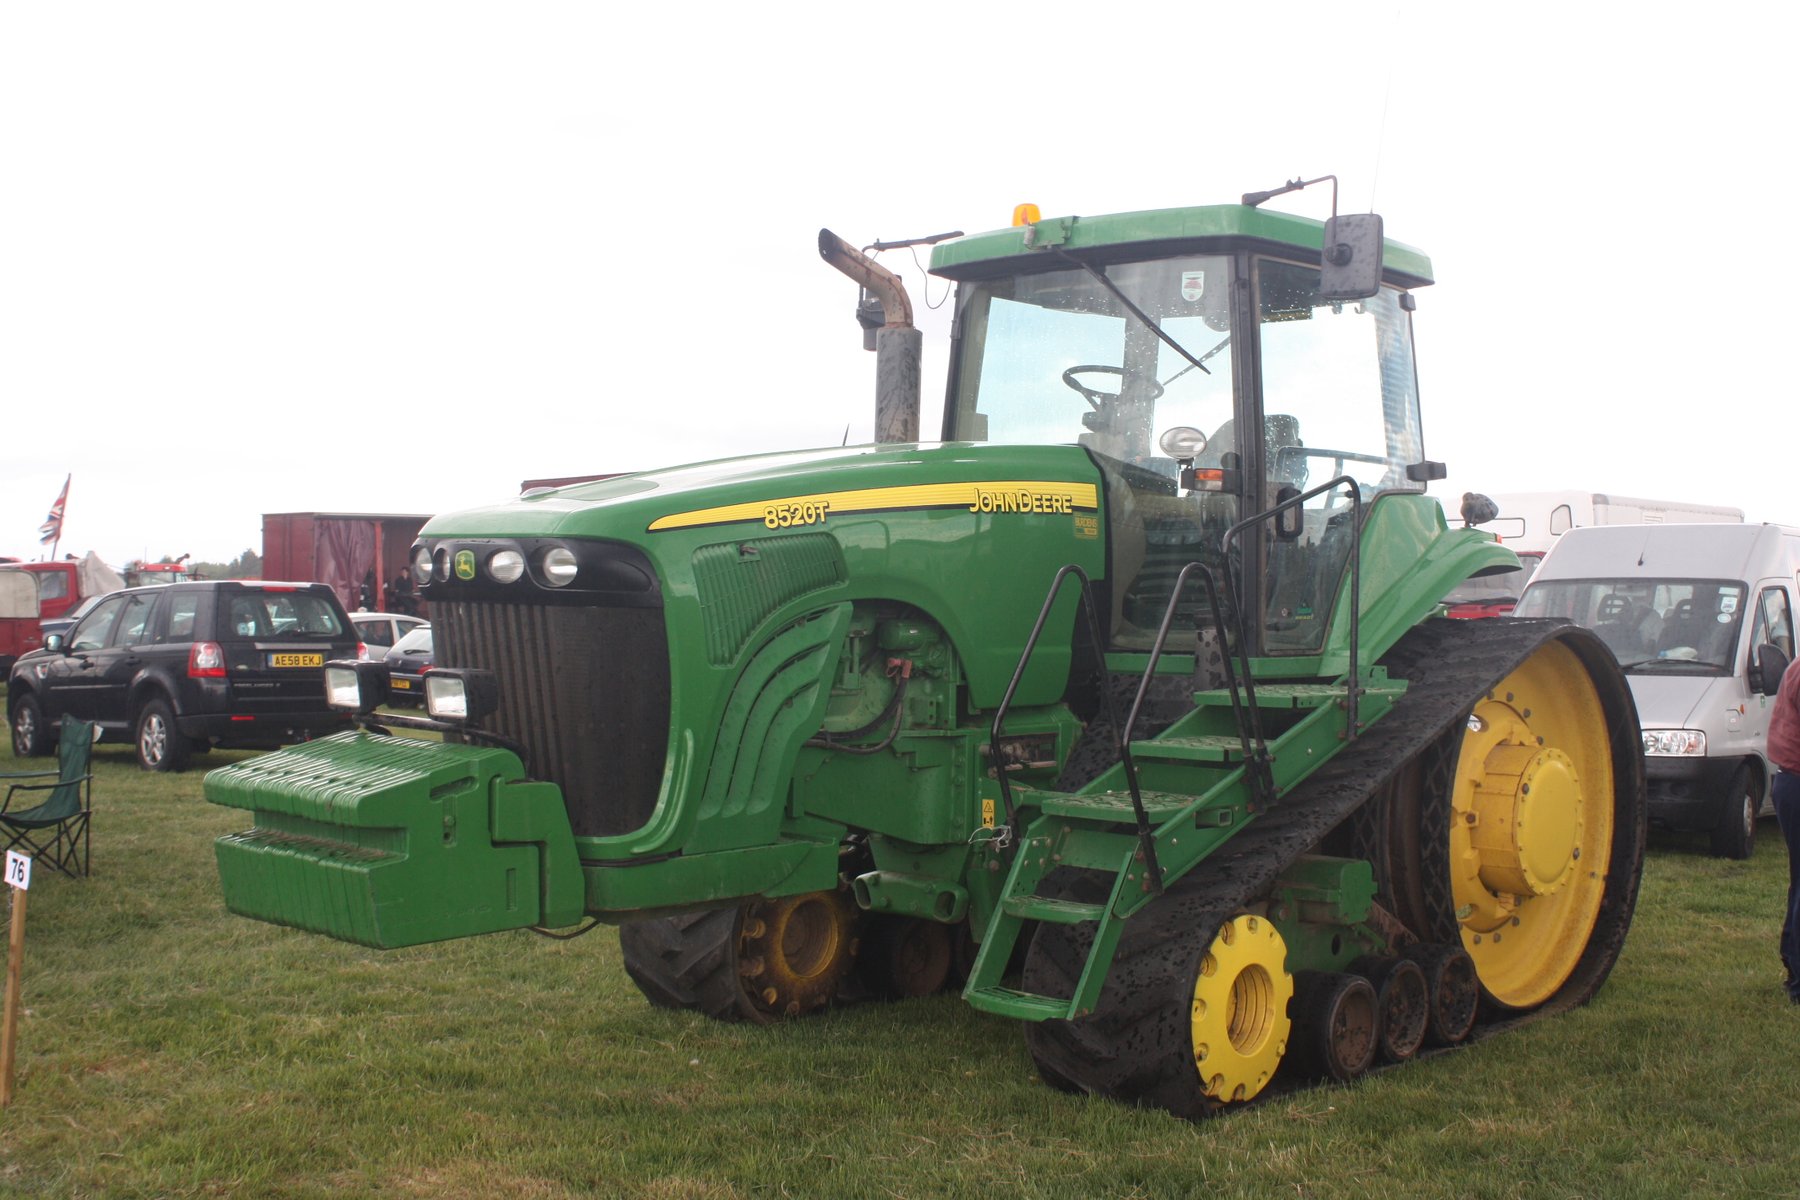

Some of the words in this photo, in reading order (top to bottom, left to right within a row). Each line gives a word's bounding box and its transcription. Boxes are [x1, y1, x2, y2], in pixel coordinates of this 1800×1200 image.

[969, 488, 1018, 513] JOHN
[1018, 489, 1073, 514] DEERE
[764, 502, 829, 529] 8520T
[275, 655, 300, 666] AE58
[302, 655, 322, 666] EKJ
[12, 858, 25, 882] 76
